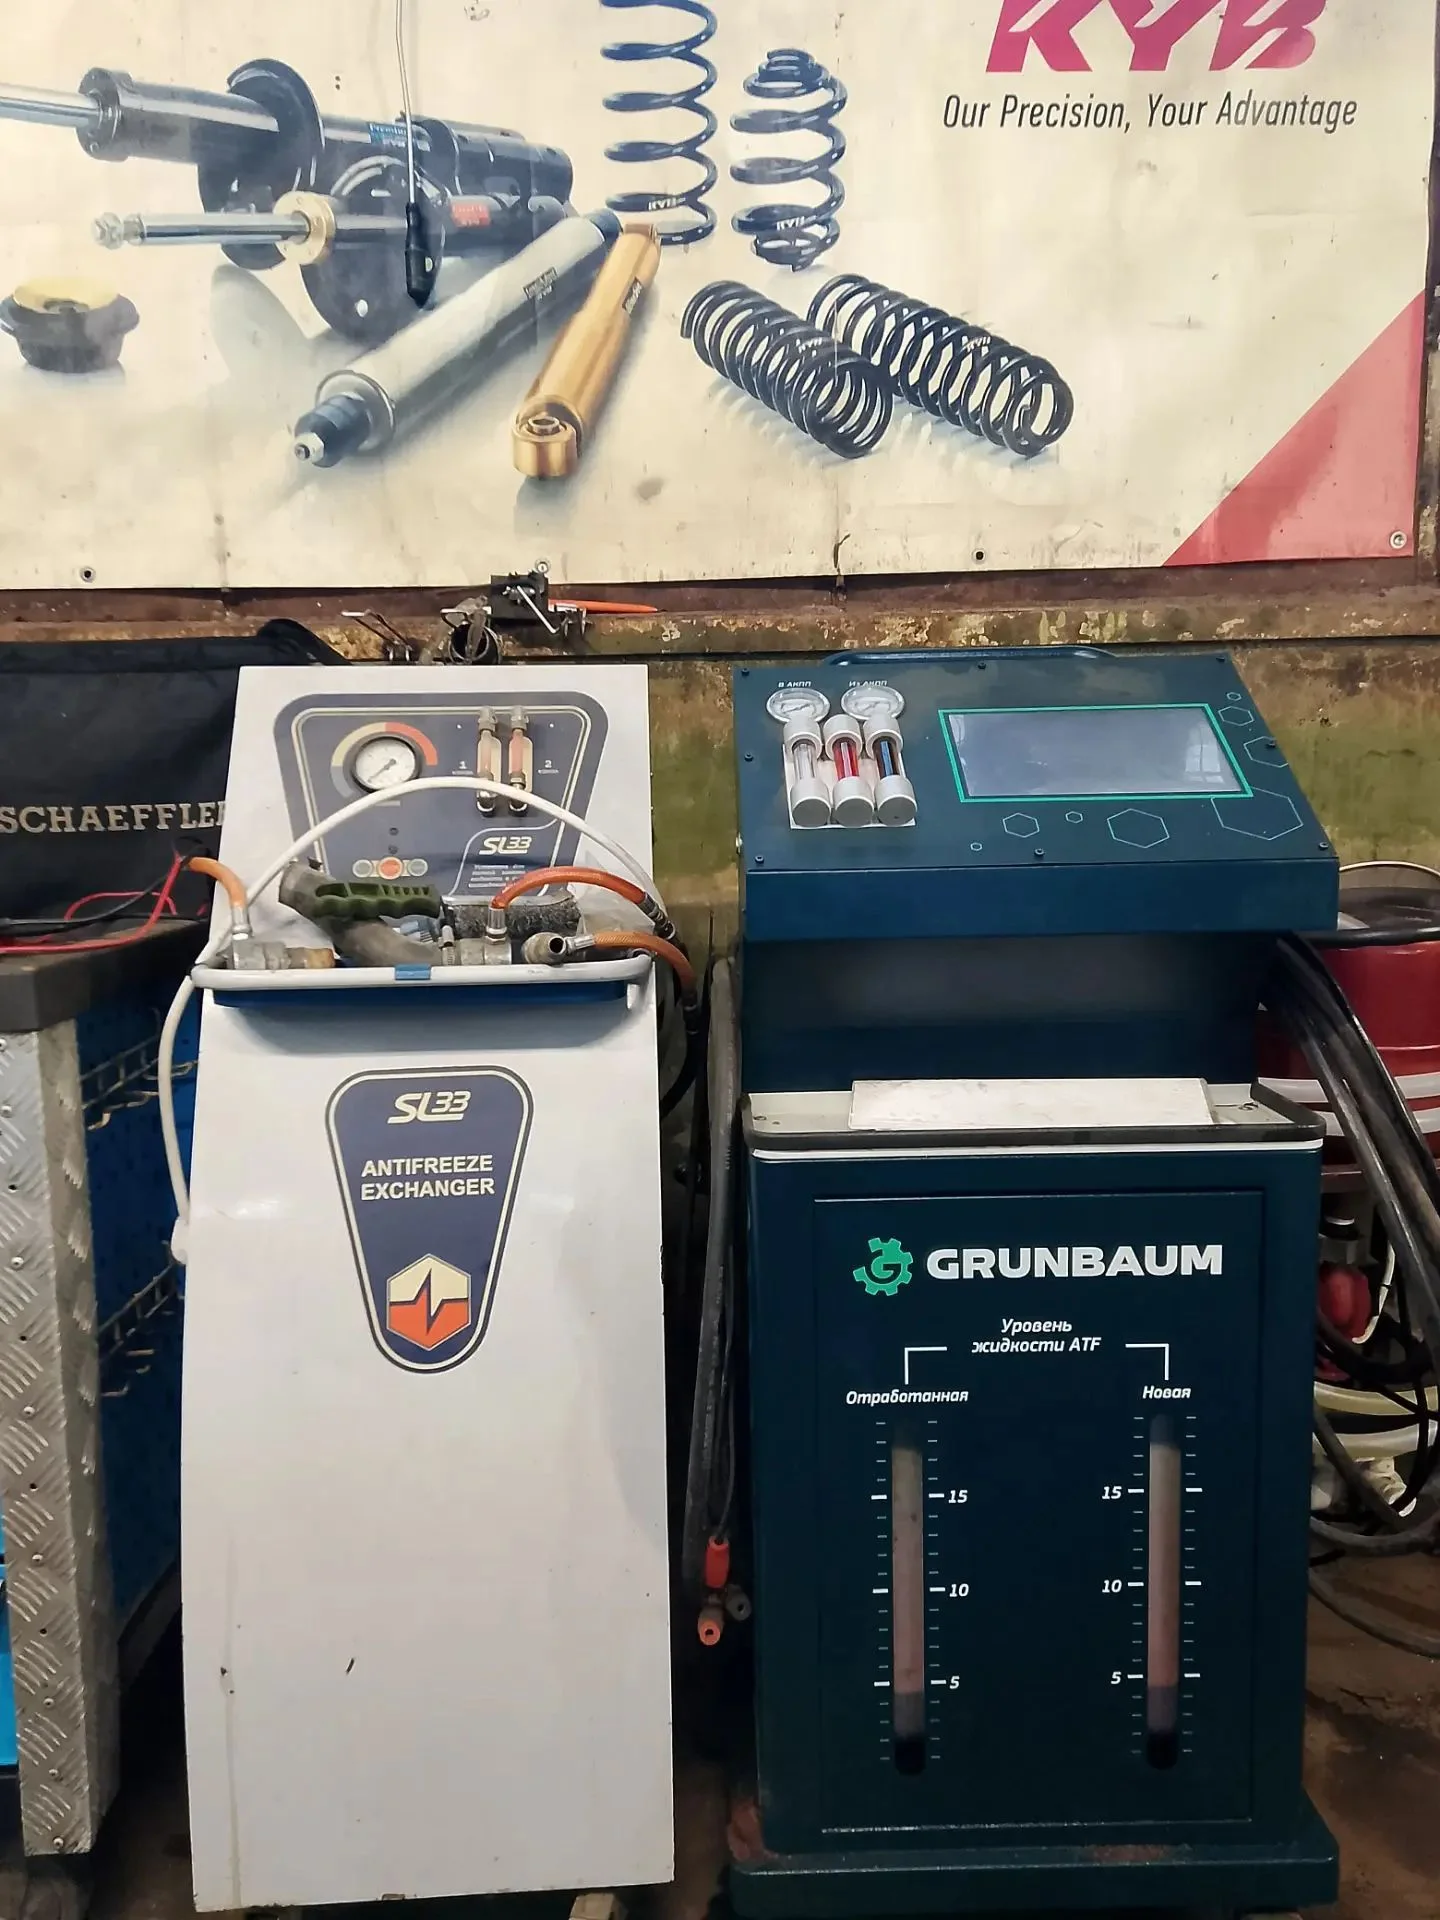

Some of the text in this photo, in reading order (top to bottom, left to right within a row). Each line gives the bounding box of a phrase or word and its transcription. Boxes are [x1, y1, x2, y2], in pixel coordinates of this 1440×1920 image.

[986, 0, 1326, 72] KYB
[943, 90, 1358, 133] Our Precision, Your Advantage
[459, 761, 467, 769] 1
[544, 760, 552, 768] 2
[479, 836, 532, 855] SL33
[387, 1090, 471, 1124] SL33
[361, 1154, 493, 1177] ANTIFREEZE
[361, 1178, 495, 1200] EXCHANGER
[926, 1244, 1223, 1280] GRUNBAUM
[1001, 1318, 1073, 1334] Уровень
[971, 1337, 1102, 1354] жидкости ATF
[846, 1389, 969, 1407] Отработанная
[1142, 1385, 1192, 1400] Новая
[948, 1489, 969, 1504] 15
[1101, 1486, 1123, 1500] 15
[949, 1583, 970, 1598] 10
[1101, 1579, 1123, 1593] 10
[949, 1675, 961, 1689] 5
[1110, 1671, 1122, 1684] 5
